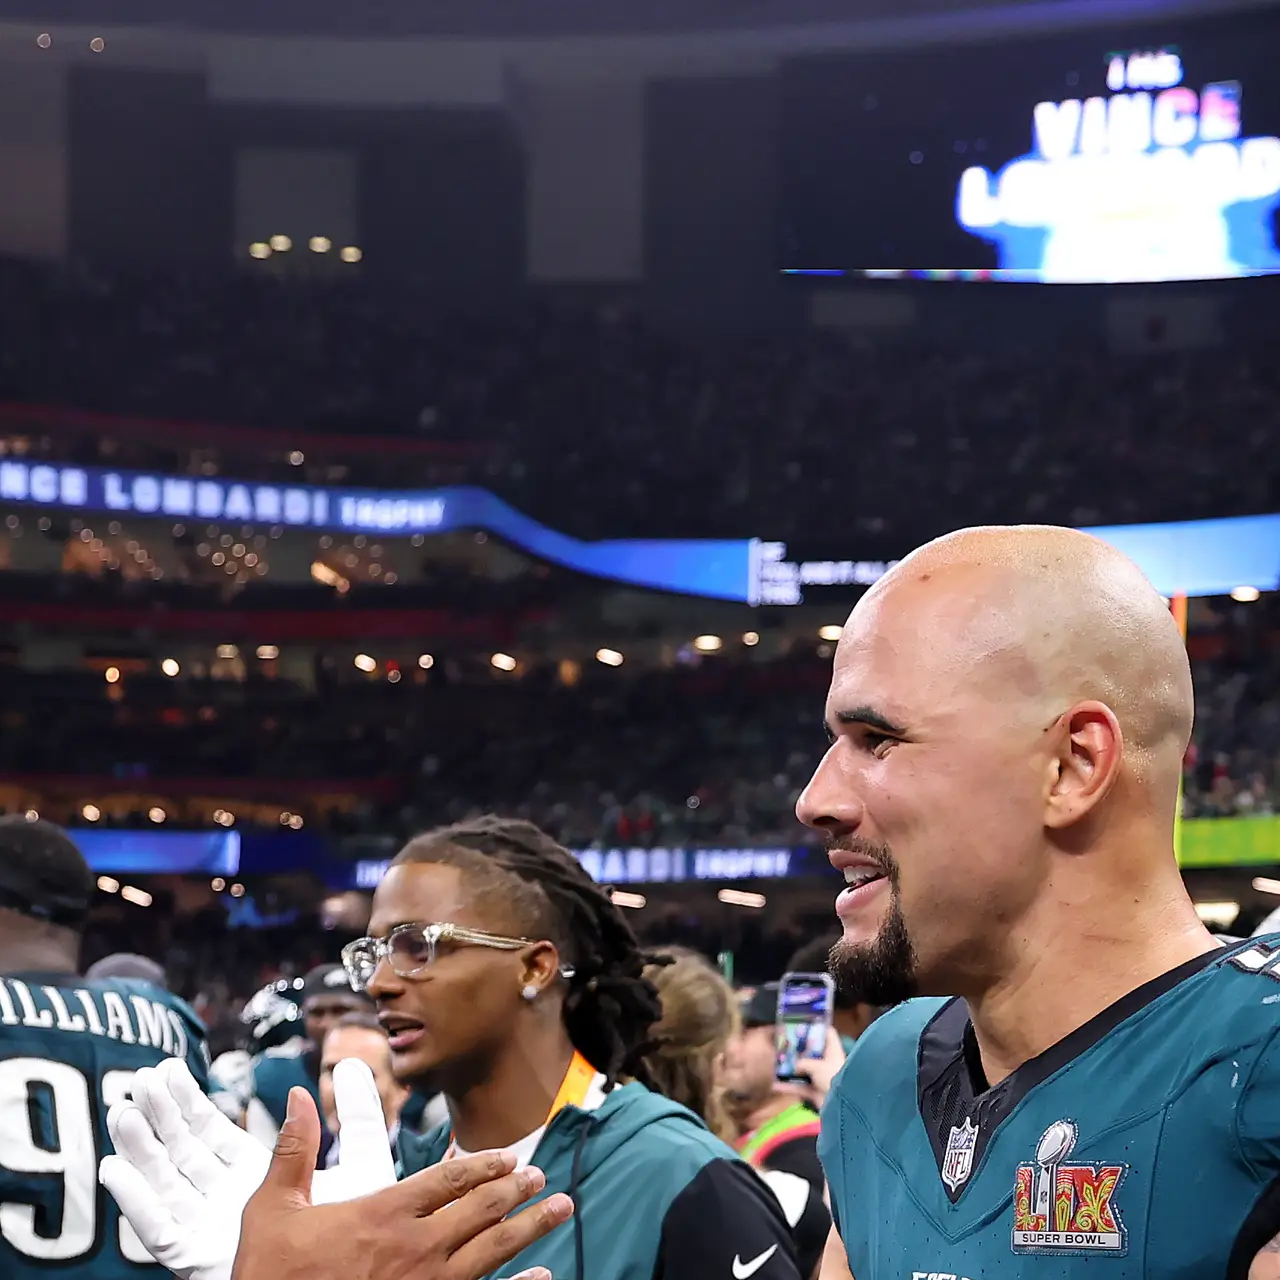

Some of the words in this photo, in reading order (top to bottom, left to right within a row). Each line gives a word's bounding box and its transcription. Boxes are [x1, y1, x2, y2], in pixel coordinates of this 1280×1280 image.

[1034, 80, 1242, 162] VINCE
[104, 472, 330, 526] LOMBARDI
[1021, 1233, 1060, 1244] SUPER
[1064, 1234, 1107, 1245] BOWL
